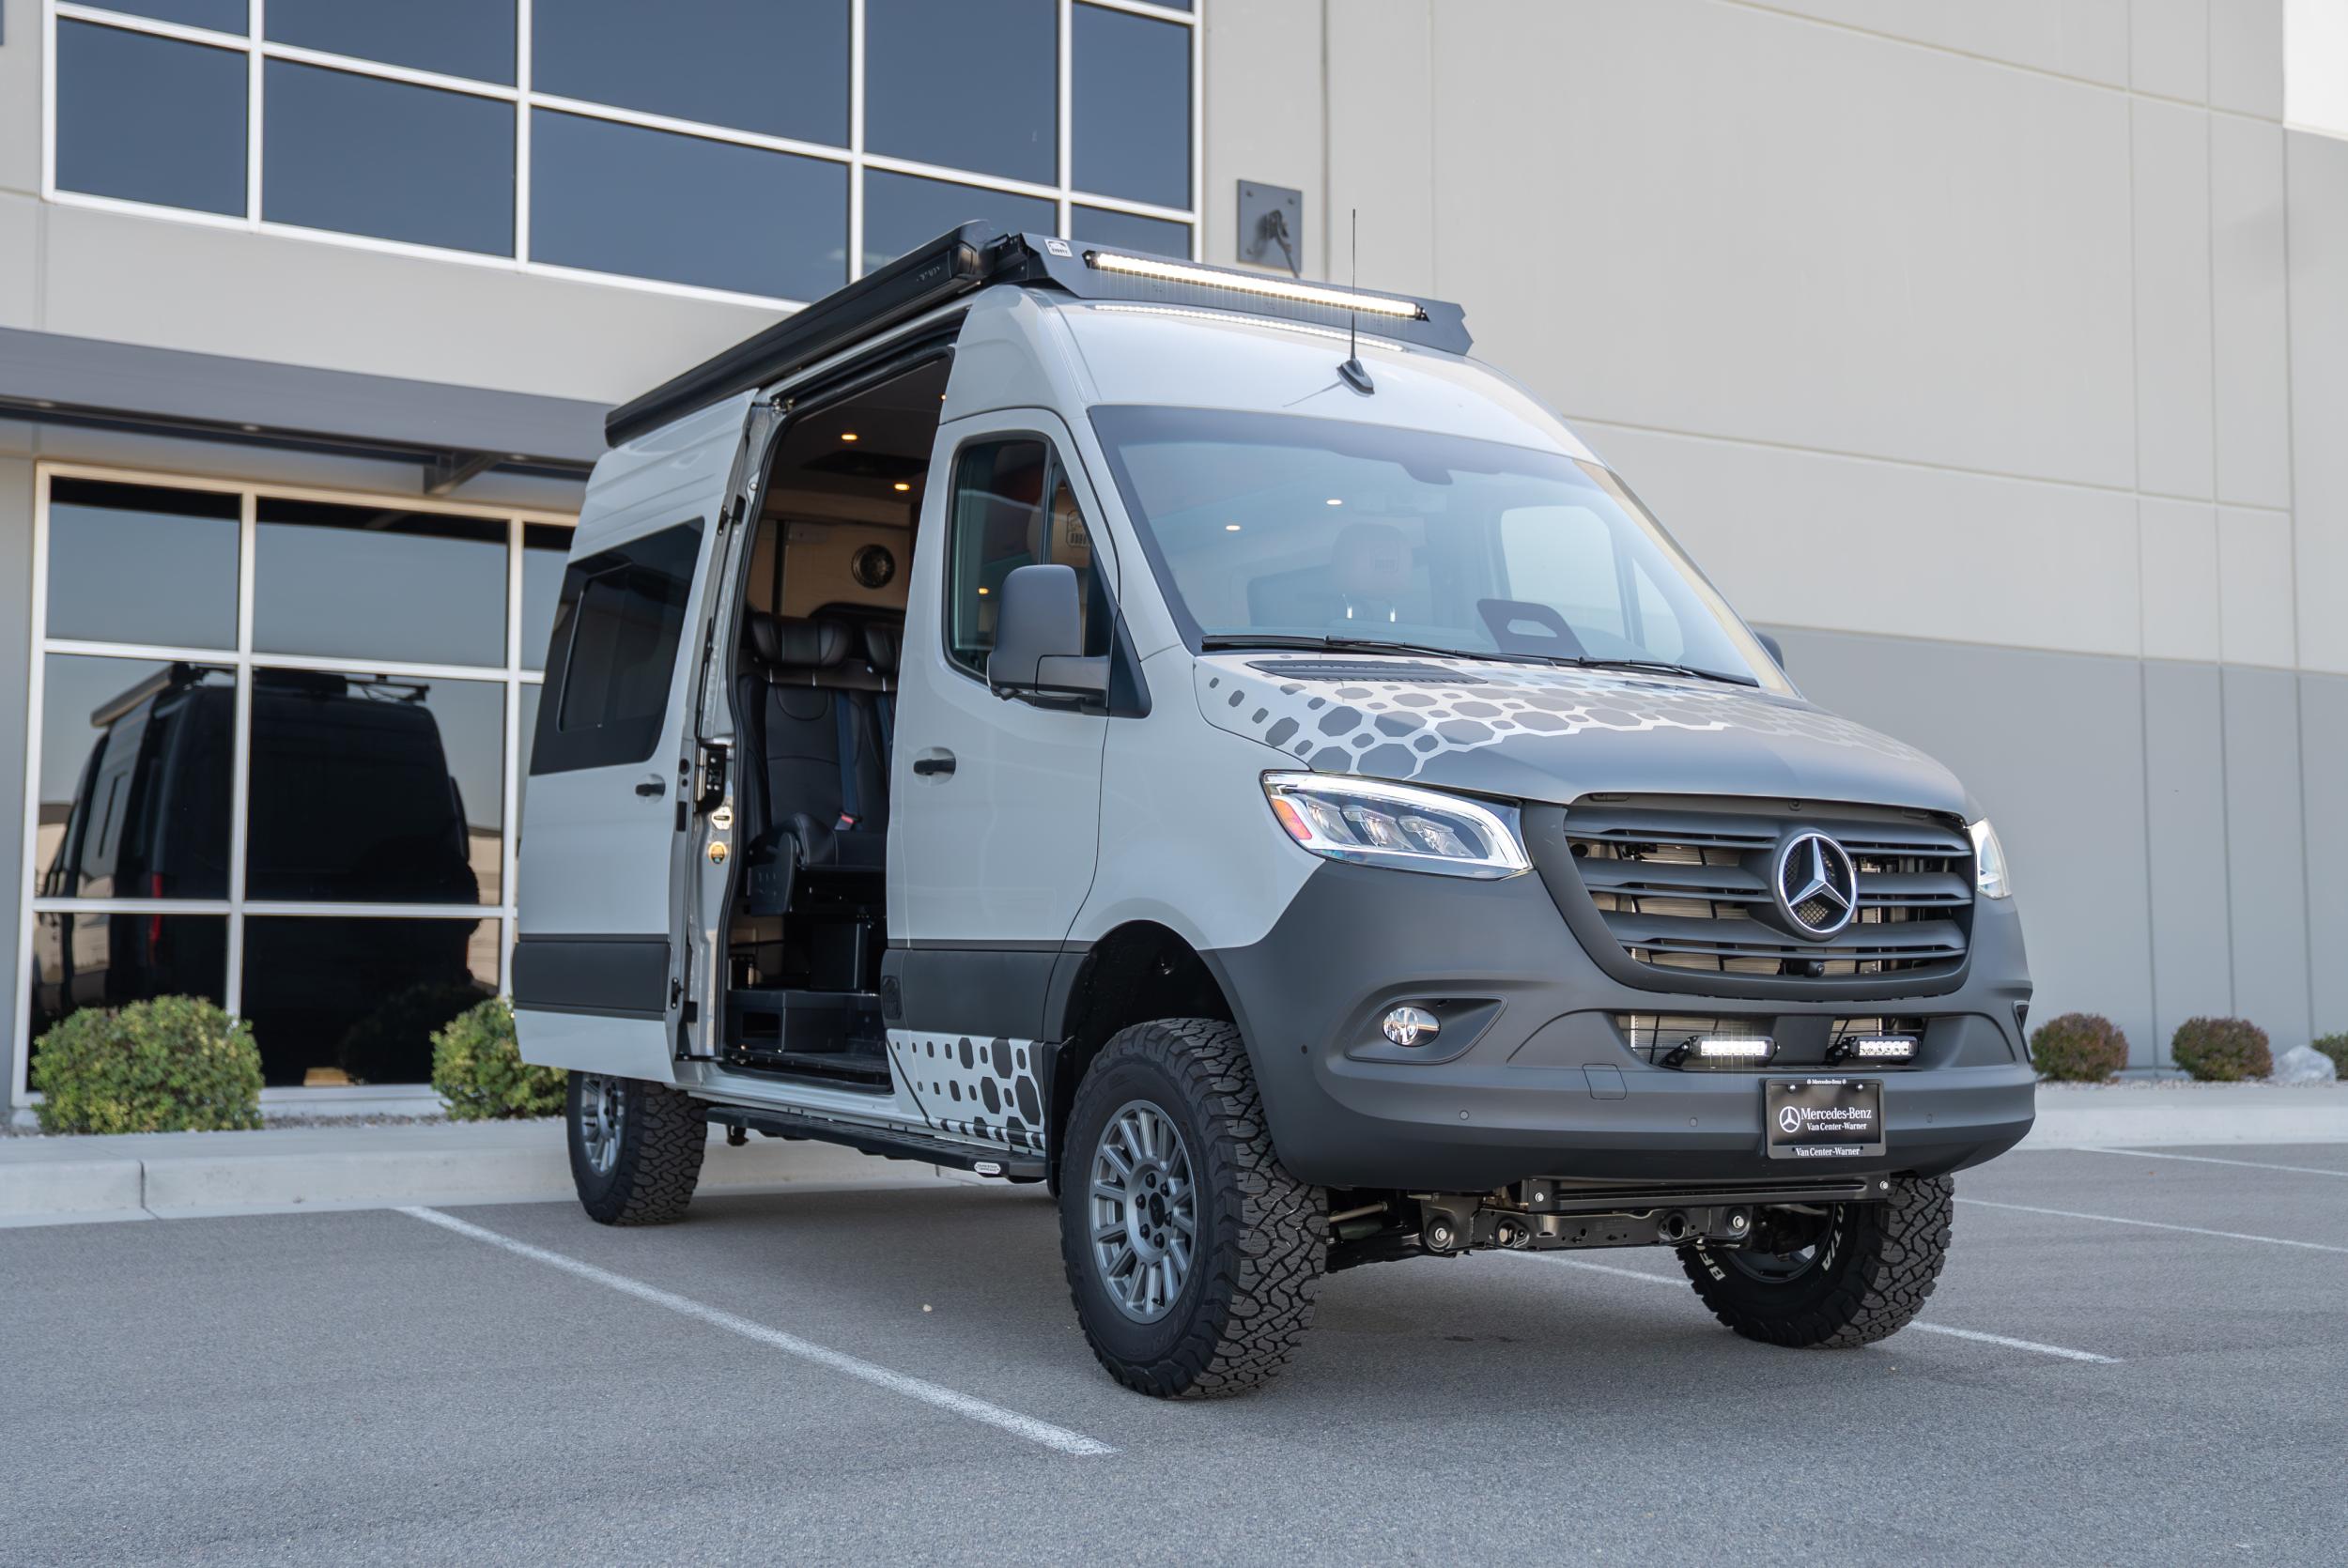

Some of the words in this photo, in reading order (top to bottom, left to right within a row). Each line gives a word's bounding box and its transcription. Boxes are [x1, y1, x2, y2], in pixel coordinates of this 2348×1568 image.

[1800, 1107, 1872, 1120] Mercedes-Benz
[1807, 1122, 1819, 1130] Van
[1820, 1122, 1867, 1130] Center-Warner
[1796, 1147, 1809, 1157] Van
[1809, 1146, 1861, 1157] Center-Warner
